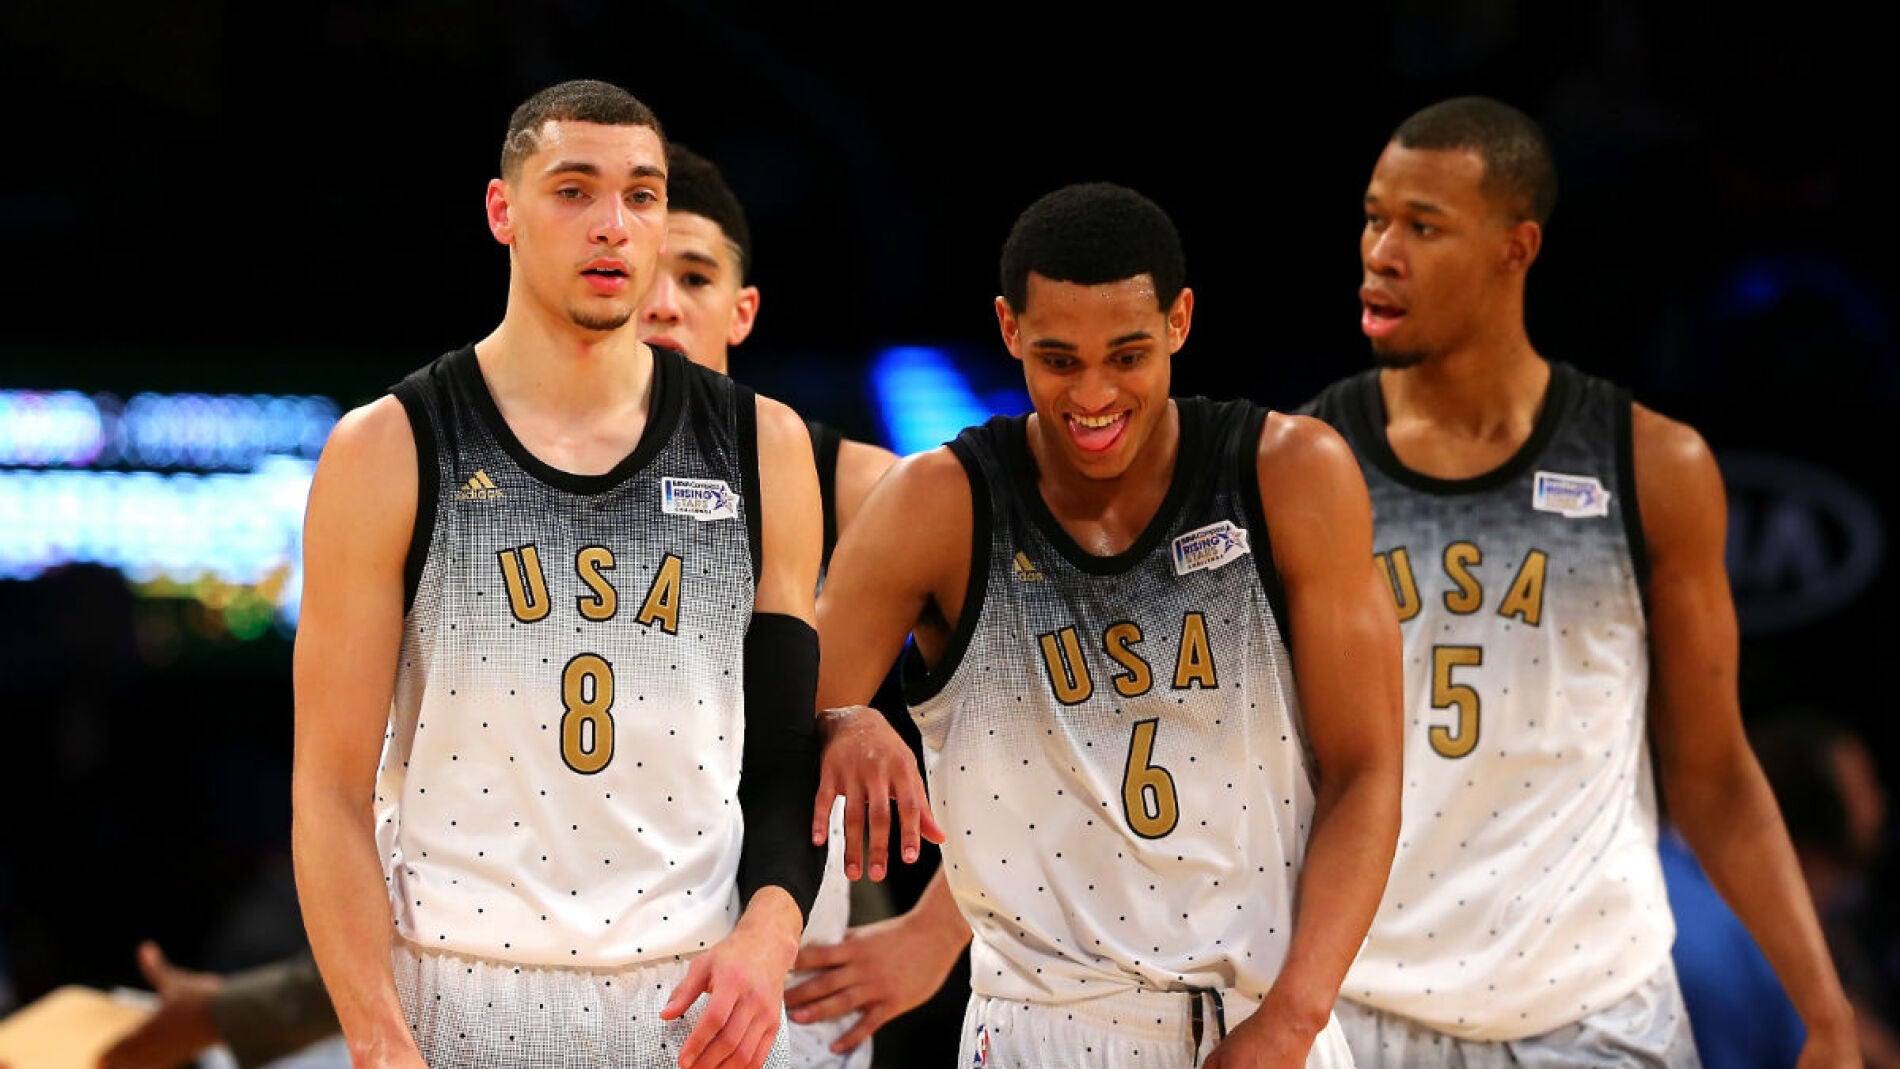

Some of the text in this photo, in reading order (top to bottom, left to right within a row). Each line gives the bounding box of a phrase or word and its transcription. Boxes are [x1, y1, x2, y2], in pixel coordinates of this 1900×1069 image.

[674, 488, 712, 499] RISING
[497, 543, 683, 636] USA
[1182, 536, 1219, 554] RISING
[1374, 540, 1548, 627] USA
[1037, 611, 1219, 706] USA
[1428, 645, 1482, 759] 5
[560, 652, 615, 775] 8
[1121, 717, 1180, 839] 6
